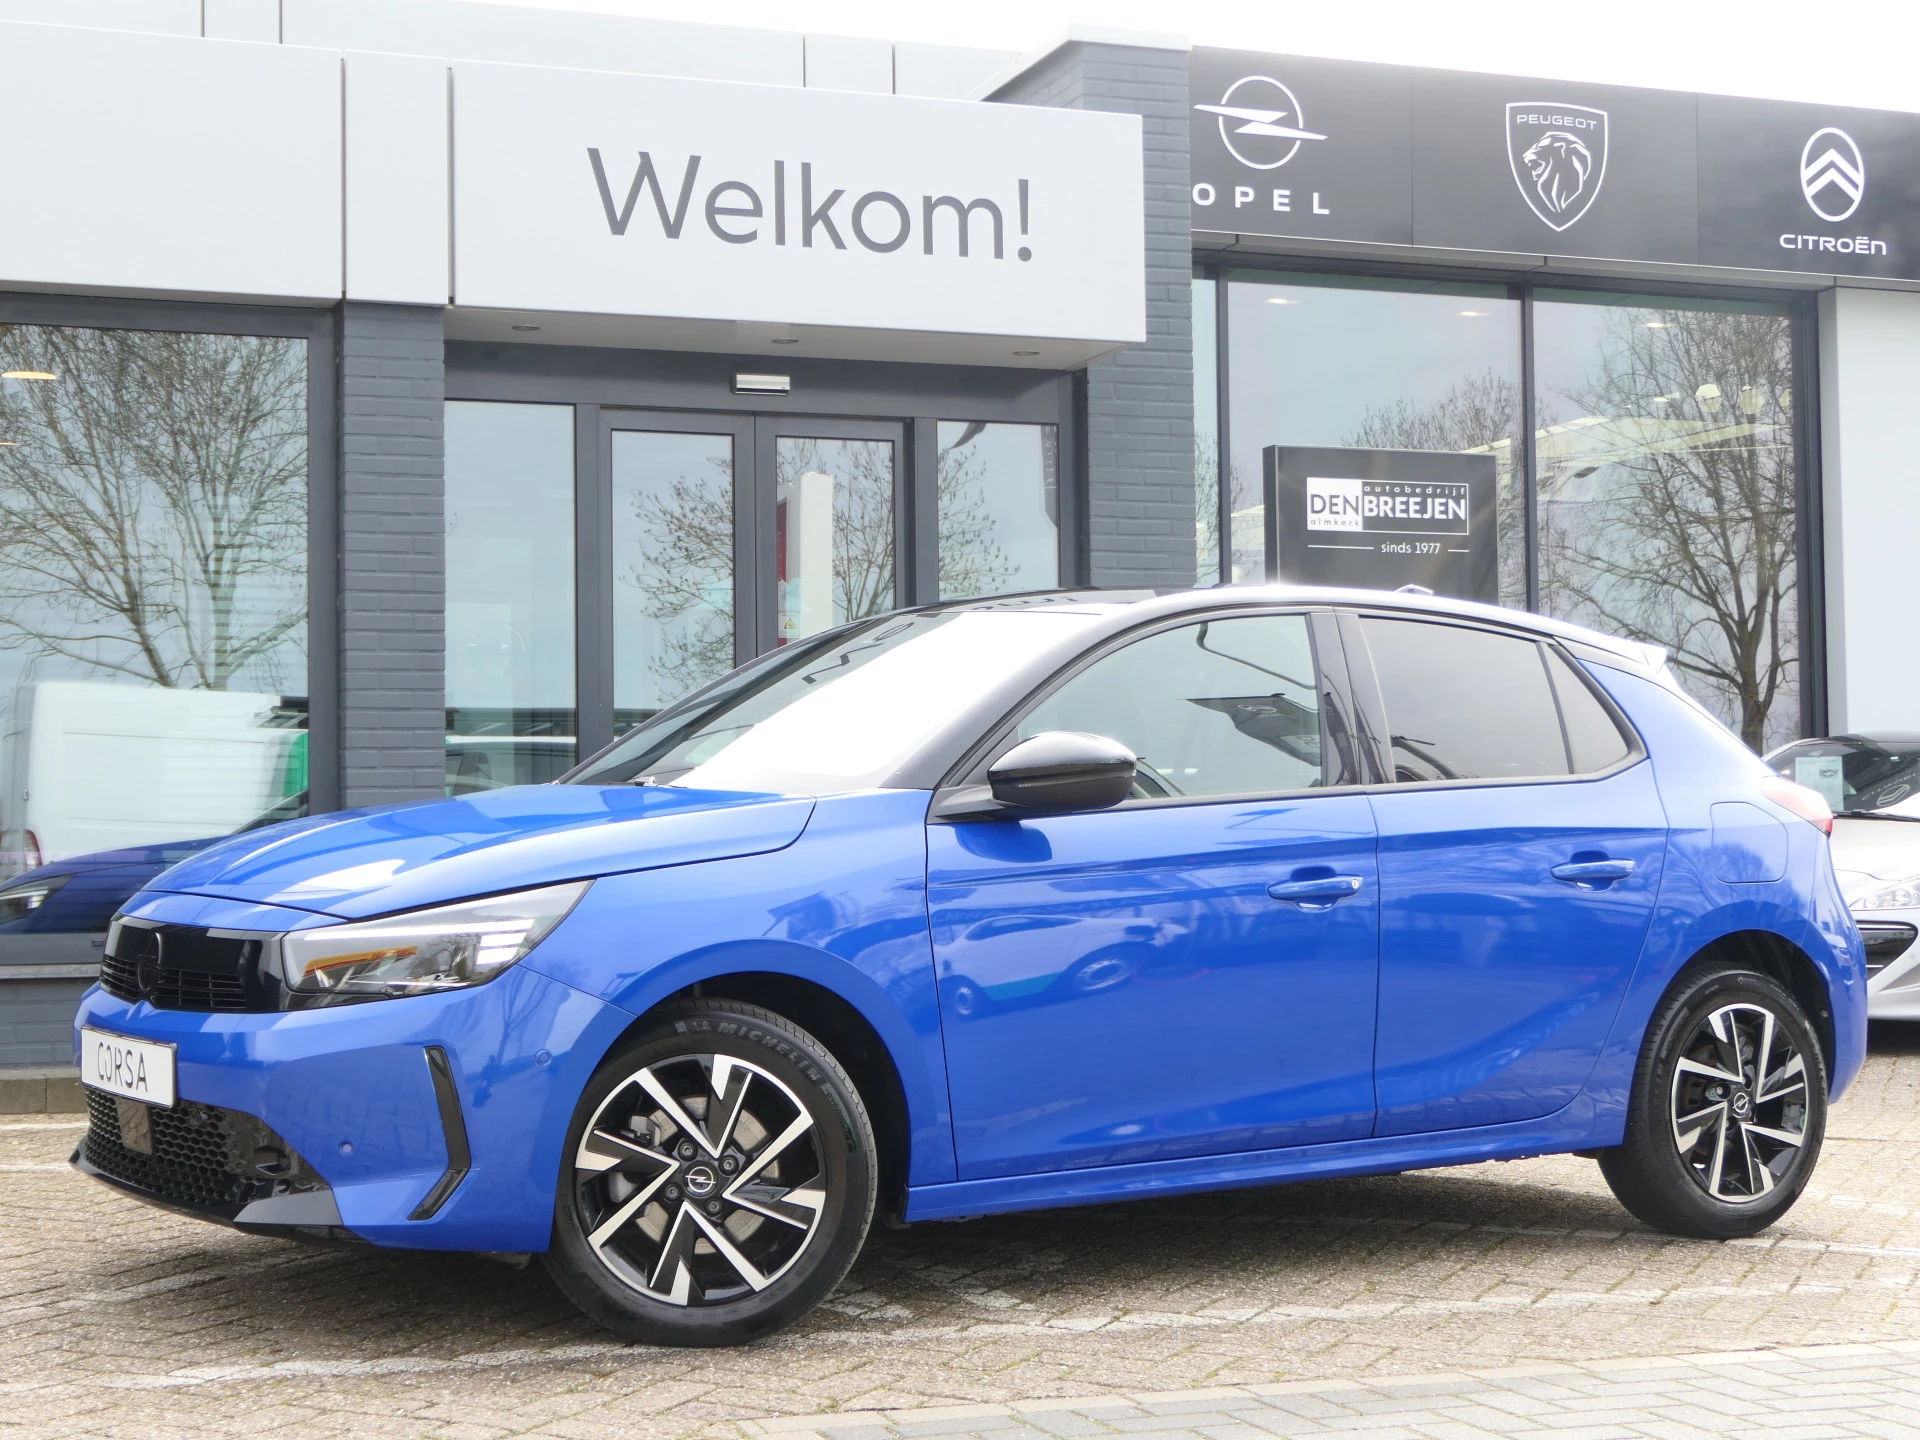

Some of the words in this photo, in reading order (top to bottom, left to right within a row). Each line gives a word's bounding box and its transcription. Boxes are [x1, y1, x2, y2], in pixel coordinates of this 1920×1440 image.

[1516, 114, 1598, 131] PEUGEOT
[586, 147, 1033, 263] Welkom!
[1192, 182, 1331, 215] OPEL
[1779, 233, 1887, 256] CITROËN
[1363, 484, 1466, 497] autobedrijf
[1310, 493, 1360, 515] DEN
[1364, 495, 1466, 520] BREEJEN
[1310, 516, 1360, 528] almkerk
[1381, 542, 1411, 554] sinds
[1414, 542, 1441, 555] 1977
[717, 1021, 822, 1082] MICHELIN
[97, 1041, 149, 1093] CORSA
